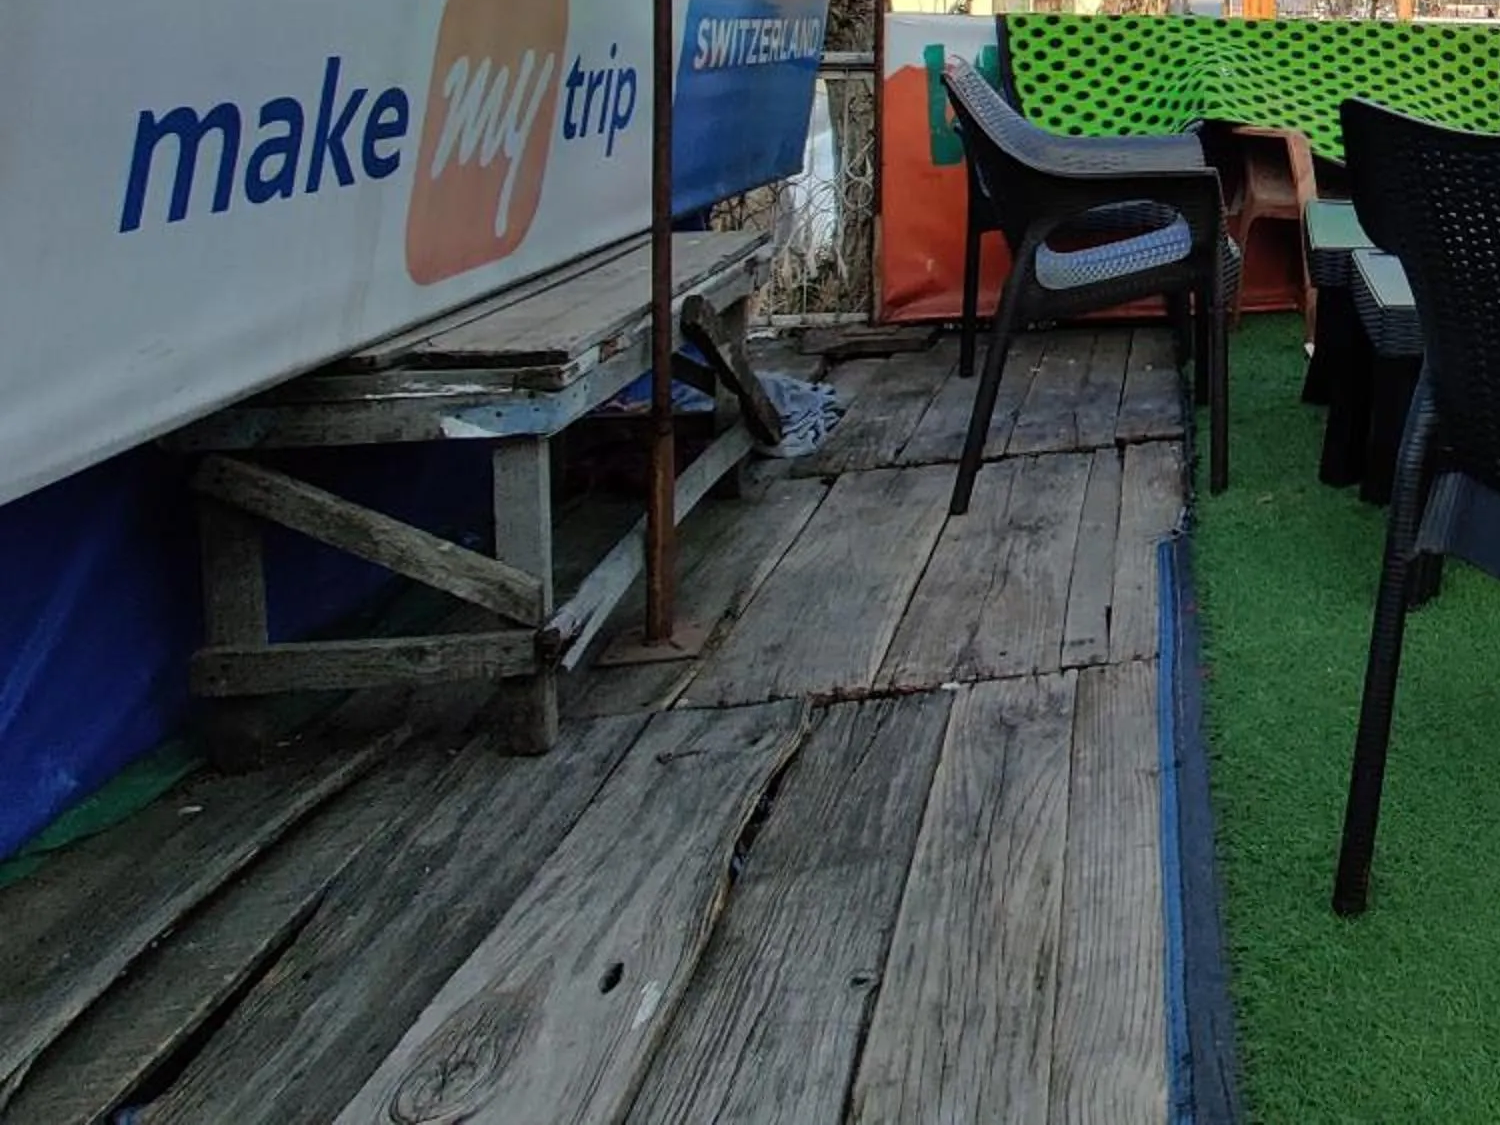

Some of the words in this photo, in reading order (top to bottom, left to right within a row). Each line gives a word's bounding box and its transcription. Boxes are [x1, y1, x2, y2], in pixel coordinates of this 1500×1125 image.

[694, 17, 821, 70] SWITZERLAND
[119, 56, 409, 233] make
[431, 48, 555, 238] my
[564, 42, 637, 158] trip
